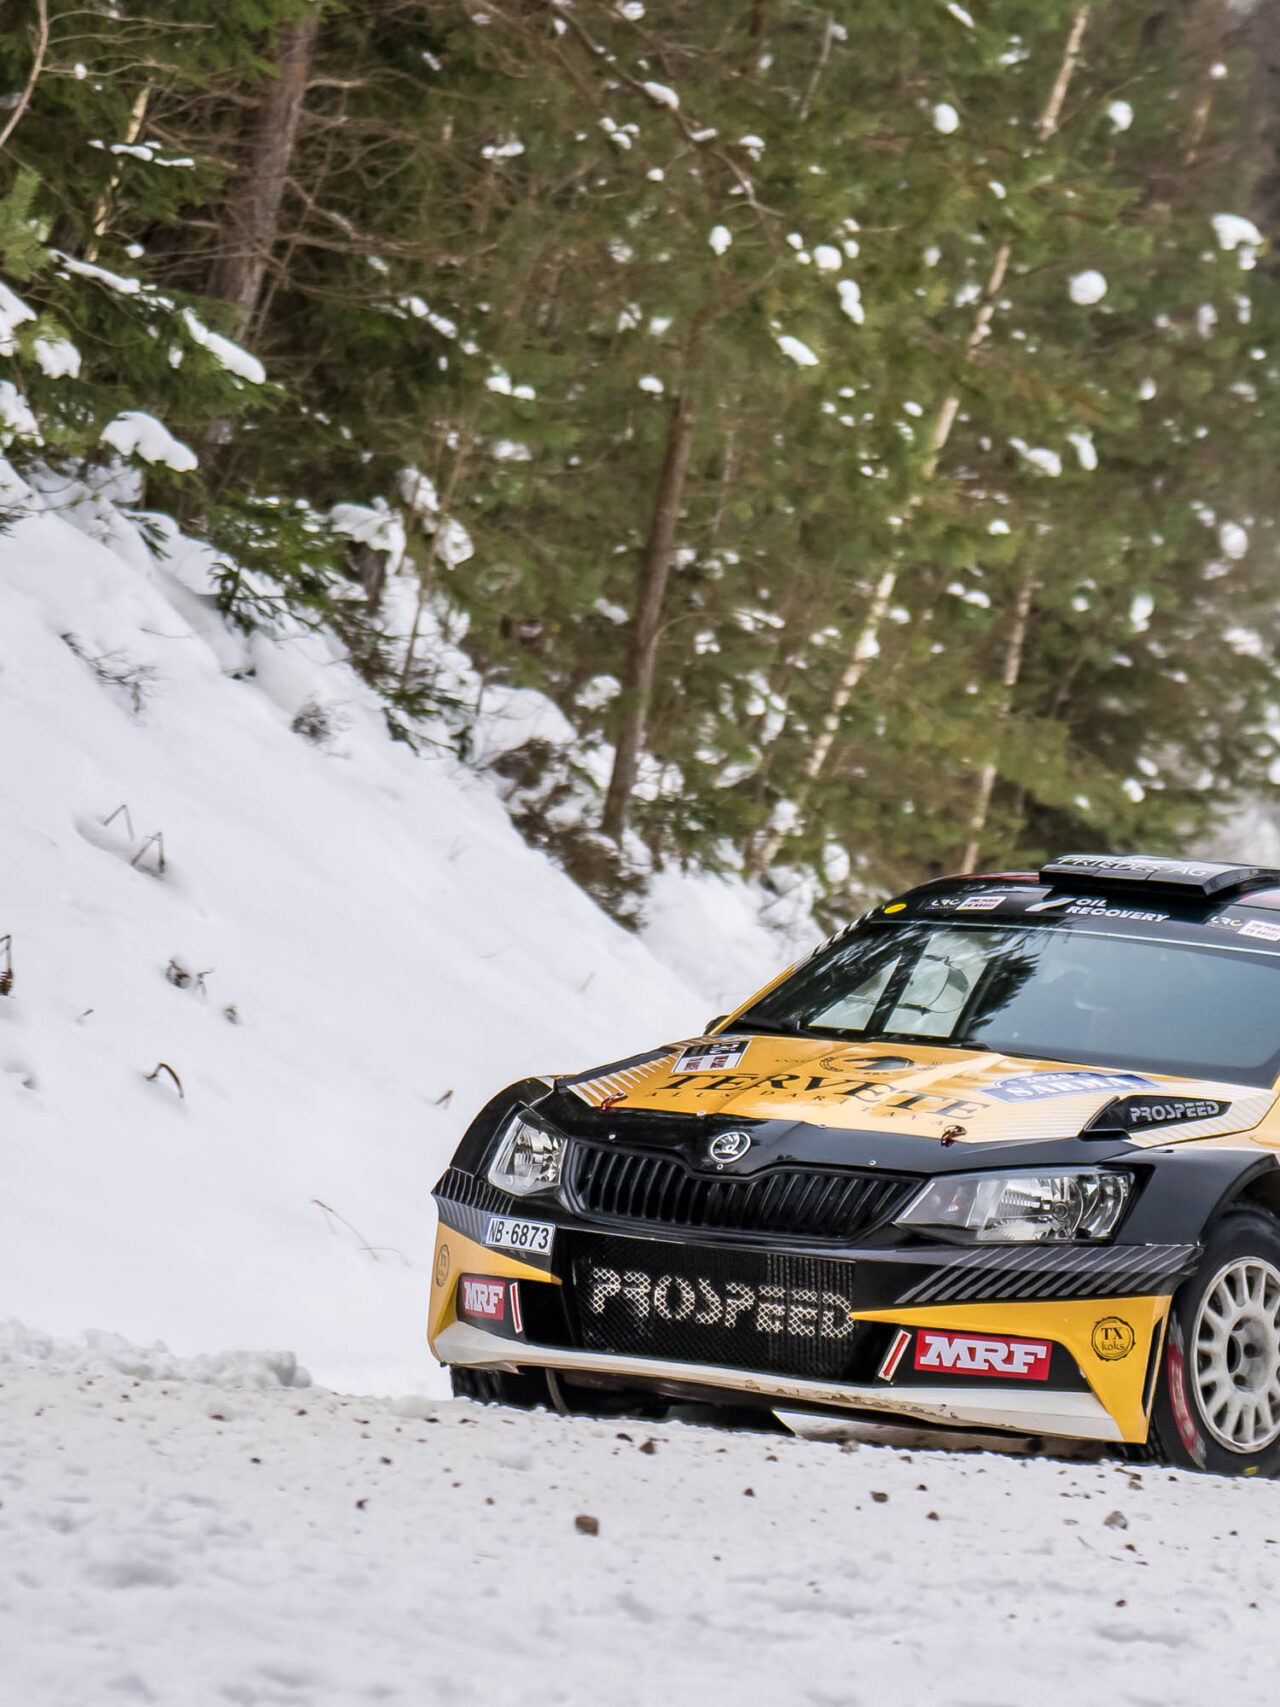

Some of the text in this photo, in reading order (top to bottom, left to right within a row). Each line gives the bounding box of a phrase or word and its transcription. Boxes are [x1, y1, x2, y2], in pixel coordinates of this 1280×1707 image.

[1075, 898, 1107, 907] OIL
[1064, 905, 1170, 923] RECOVERY
[1006, 1076, 1133, 1097] SARMA
[1130, 1100, 1220, 1122] PROSPEED
[463, 1281, 504, 1314] MRF
[590, 1266, 855, 1338] PROSPEED
[1100, 1327, 1123, 1340] TX
[919, 1335, 1047, 1374] MRF
[1102, 1341, 1125, 1351] koks
